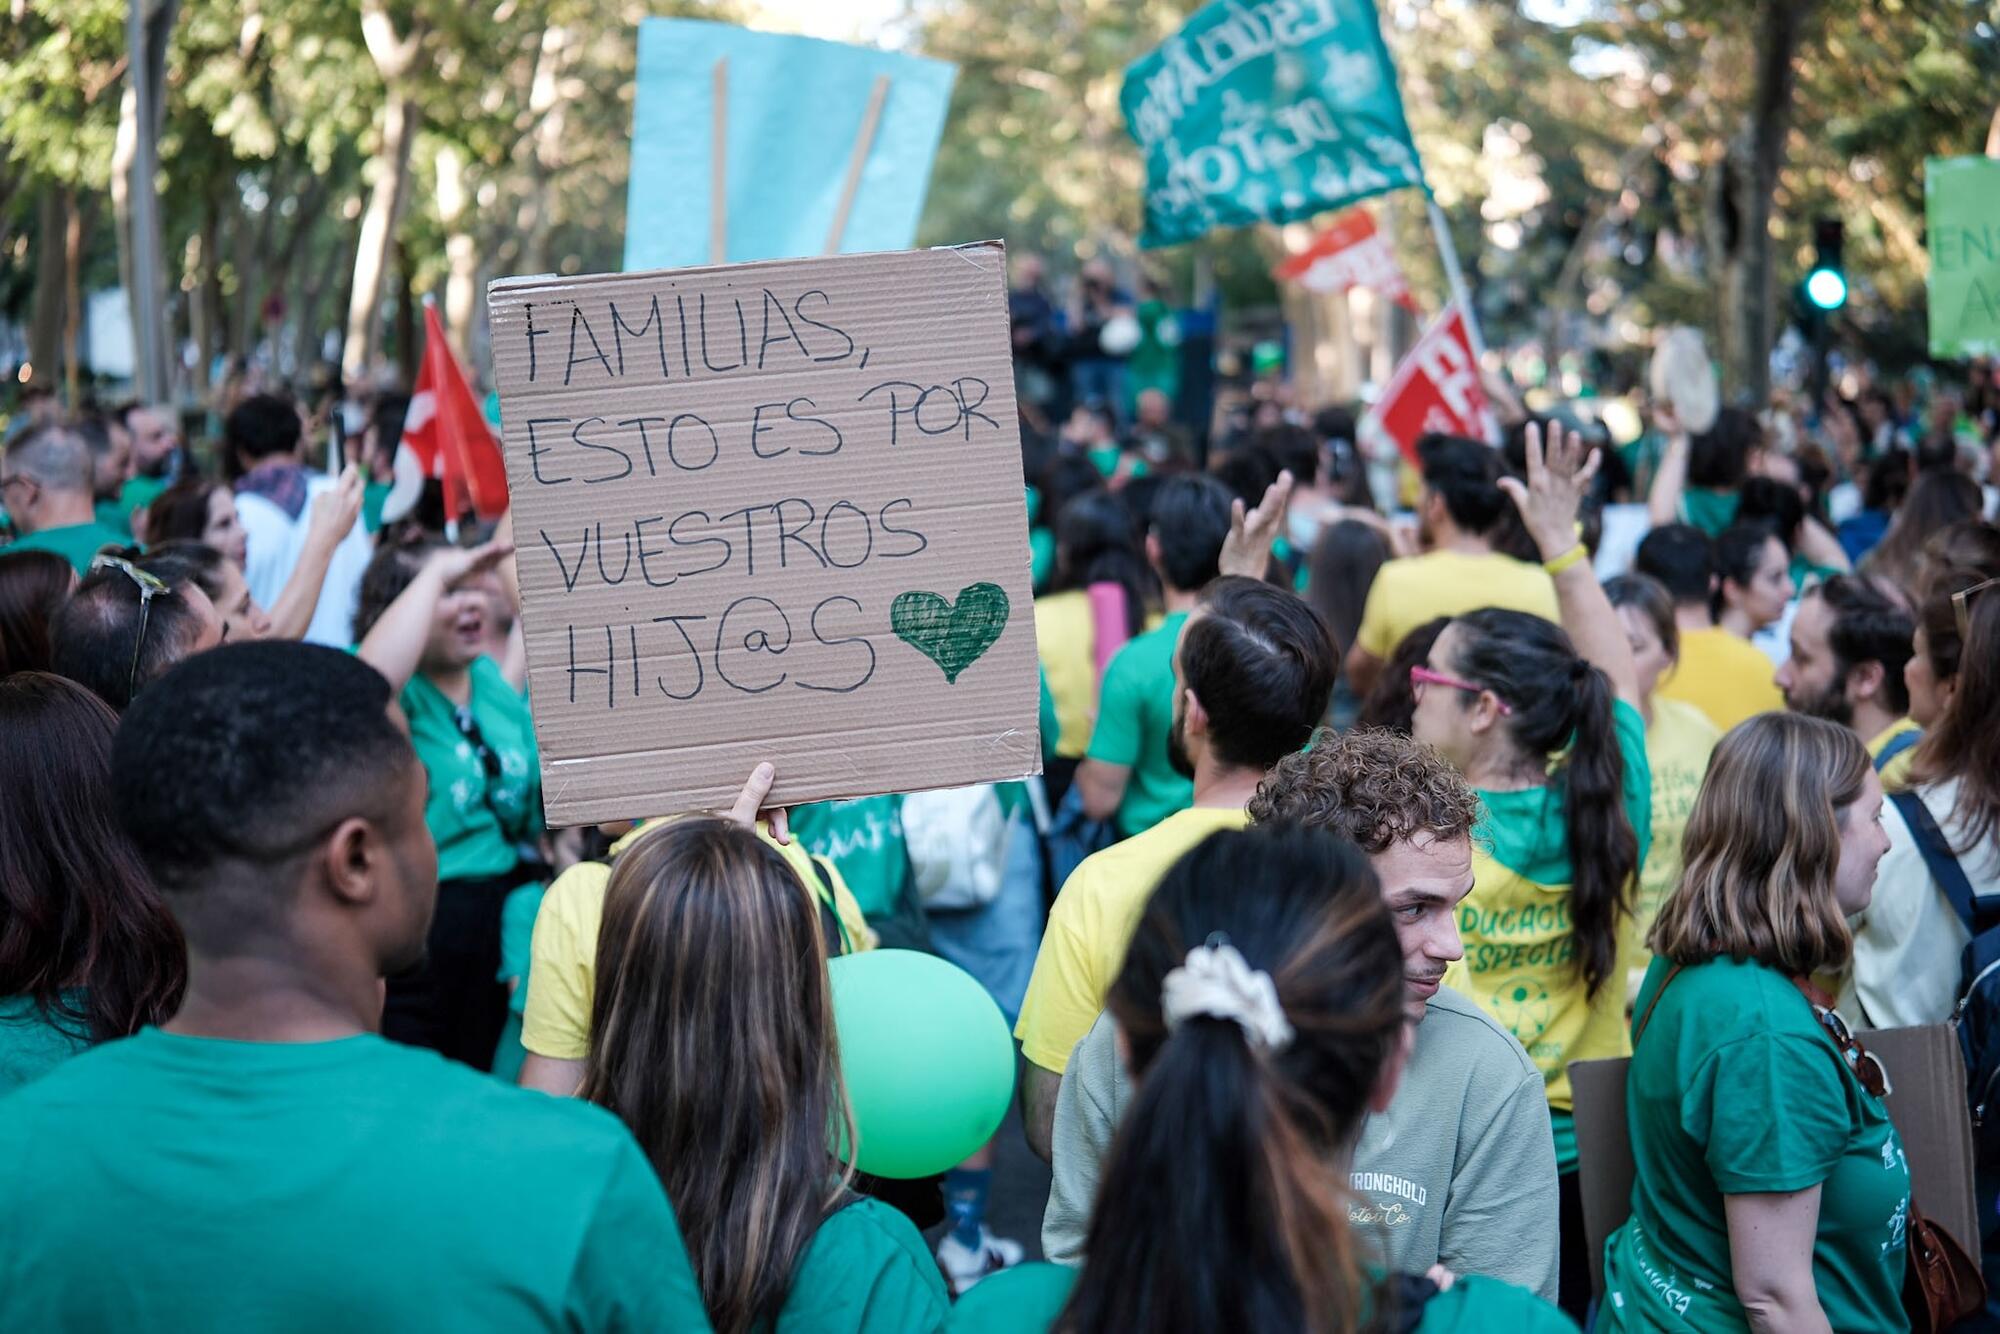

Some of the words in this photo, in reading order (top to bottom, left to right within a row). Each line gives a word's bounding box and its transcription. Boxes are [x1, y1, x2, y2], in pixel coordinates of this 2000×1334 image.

[1935, 223, 2000, 272] EN
[524, 283, 870, 386] FAMILIAS,
[527, 413, 720, 485] ESTO
[751, 397, 844, 459] ES
[857, 376, 1000, 446] POR
[540, 498, 928, 593] VUESTROS
[566, 595, 876, 709] HIJ@S
[1459, 896, 1574, 937] DUCACI
[1345, 1203, 1383, 1224] otor
